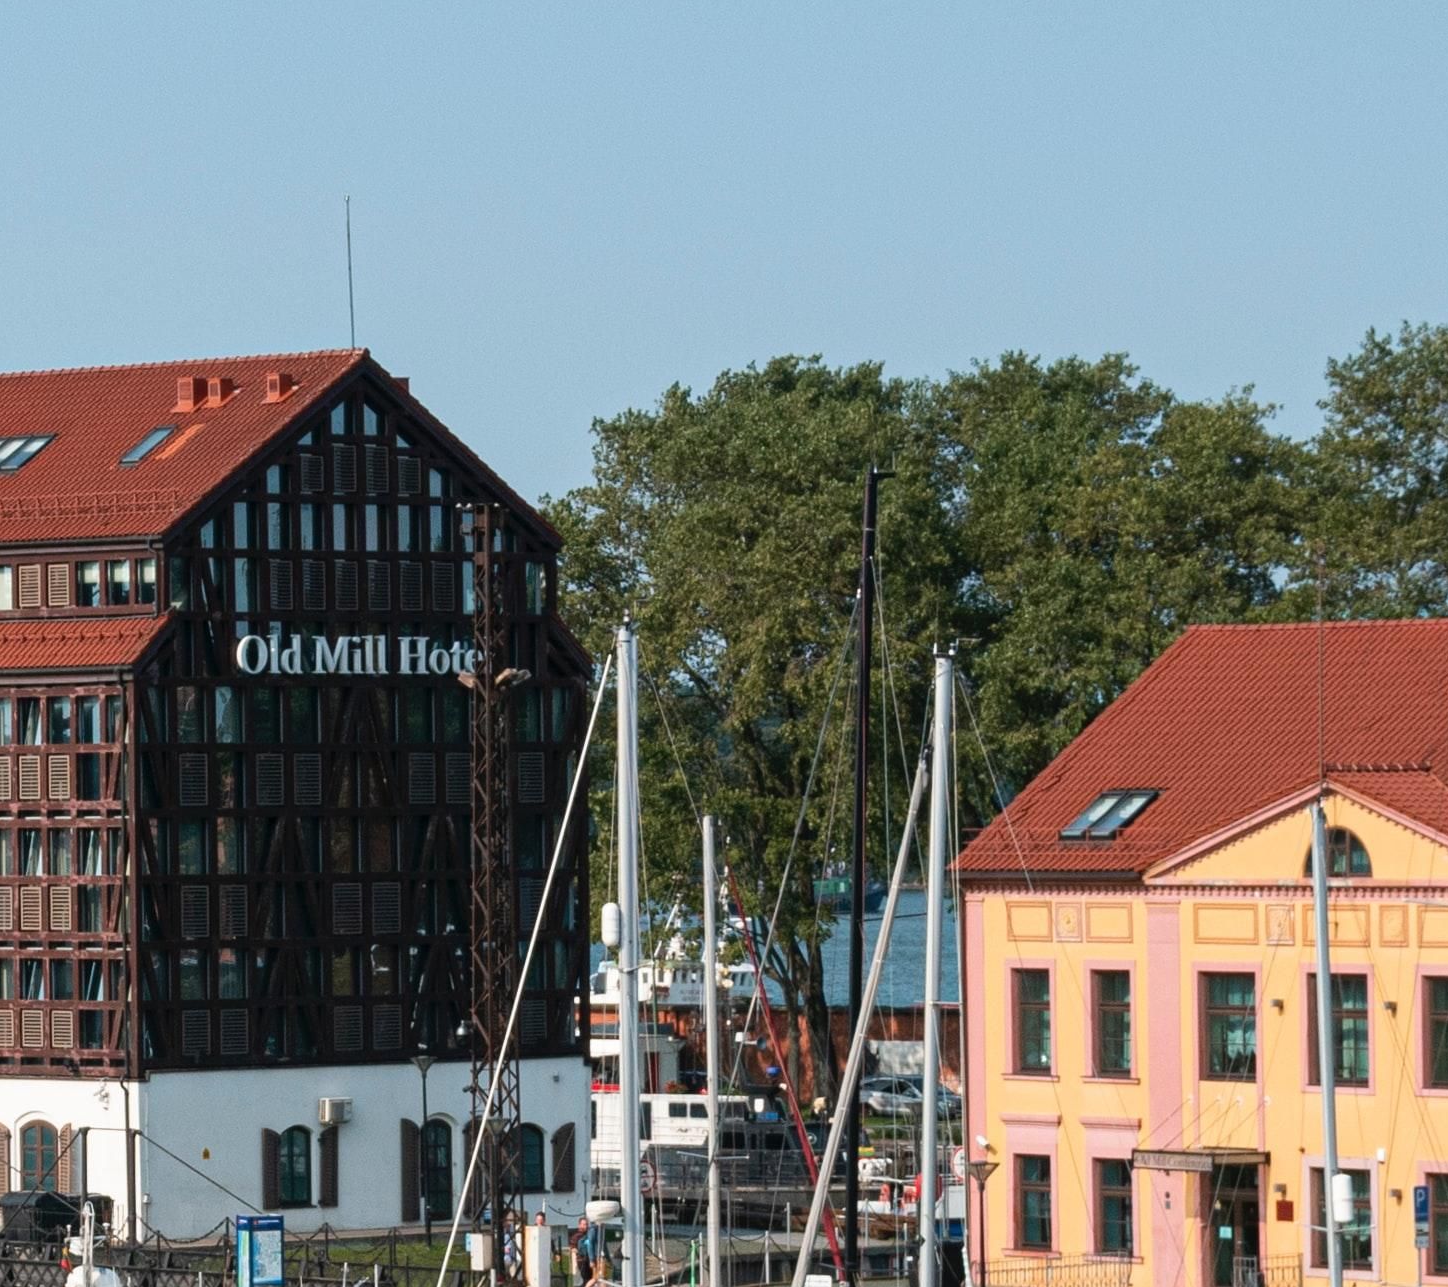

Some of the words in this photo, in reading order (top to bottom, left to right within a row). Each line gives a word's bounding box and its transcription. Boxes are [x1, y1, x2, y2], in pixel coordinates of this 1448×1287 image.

[236, 634, 303, 675] Old
[311, 634, 389, 675] Mill
[397, 635, 487, 675] Hote
[1416, 1188, 1426, 1207] P
